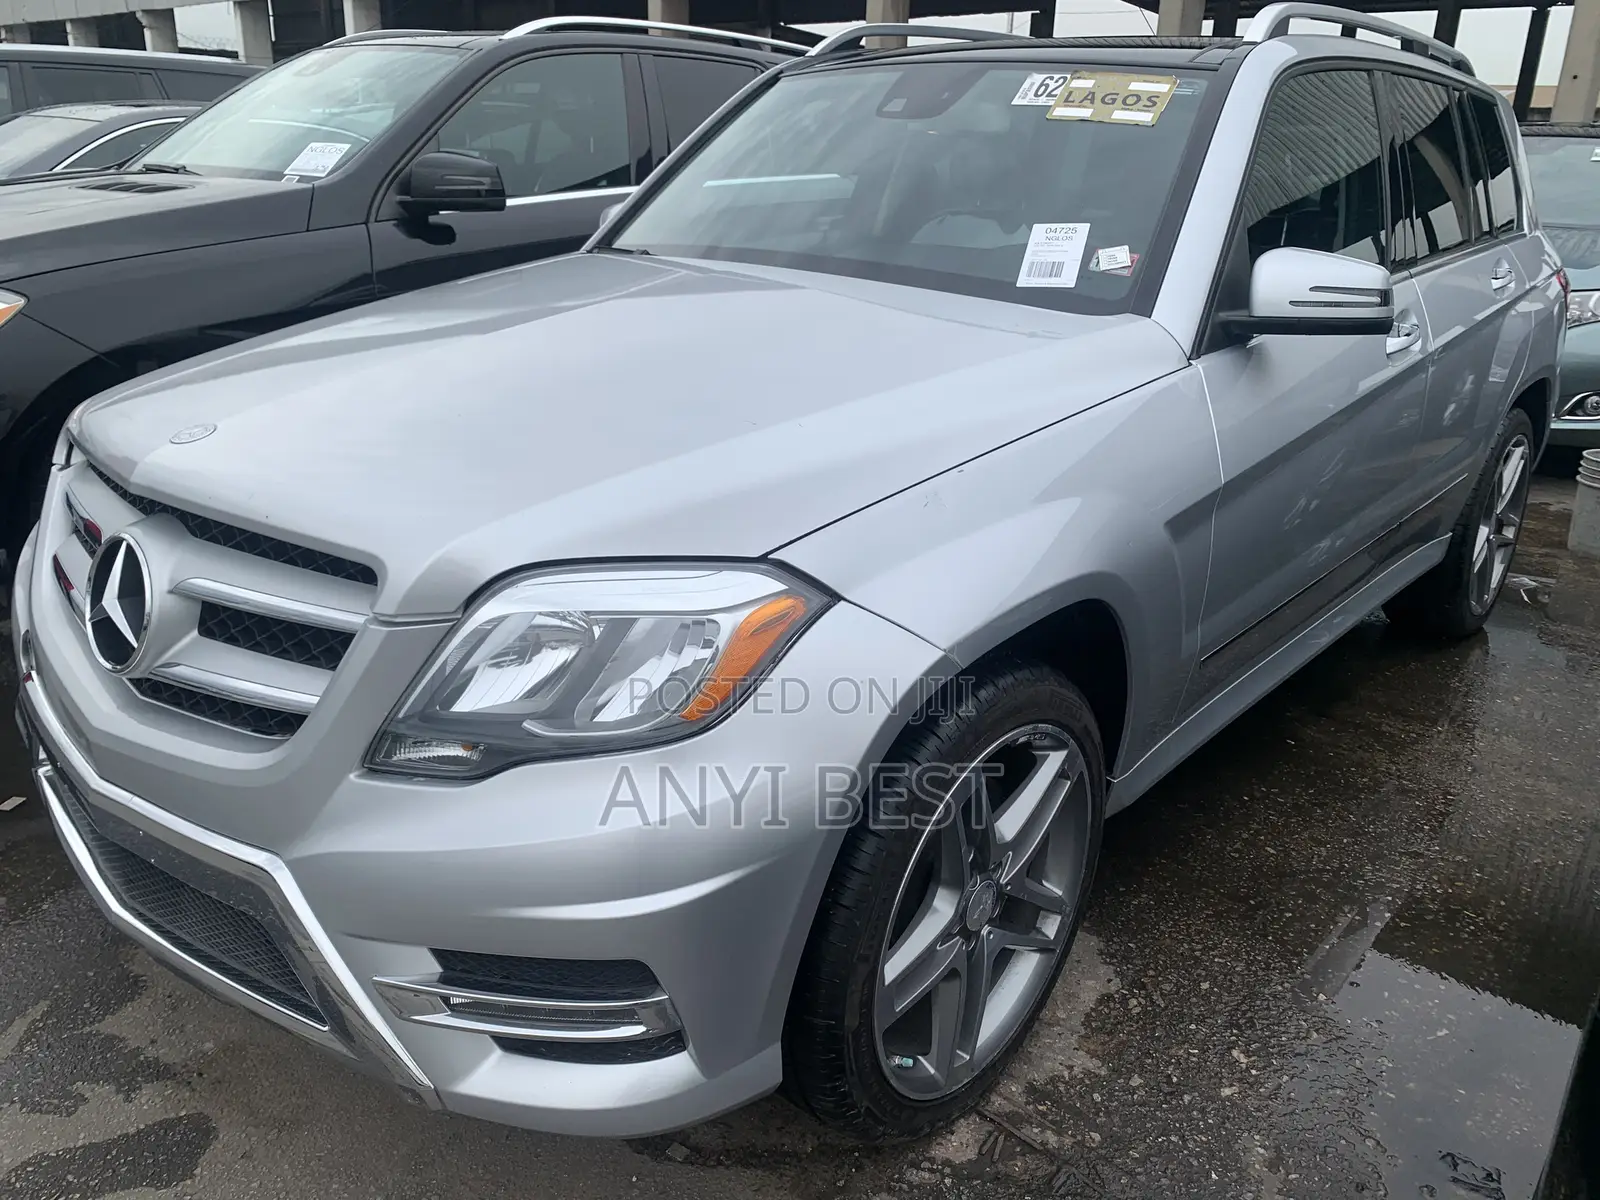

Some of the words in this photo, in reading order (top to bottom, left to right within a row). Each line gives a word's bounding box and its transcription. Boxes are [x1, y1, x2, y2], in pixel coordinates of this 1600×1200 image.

[1033, 75, 1068, 98] 62
[1063, 90, 1161, 109] LAGOS
[306, 146, 346, 155] NGLOS
[1045, 226, 1078, 235] 04725
